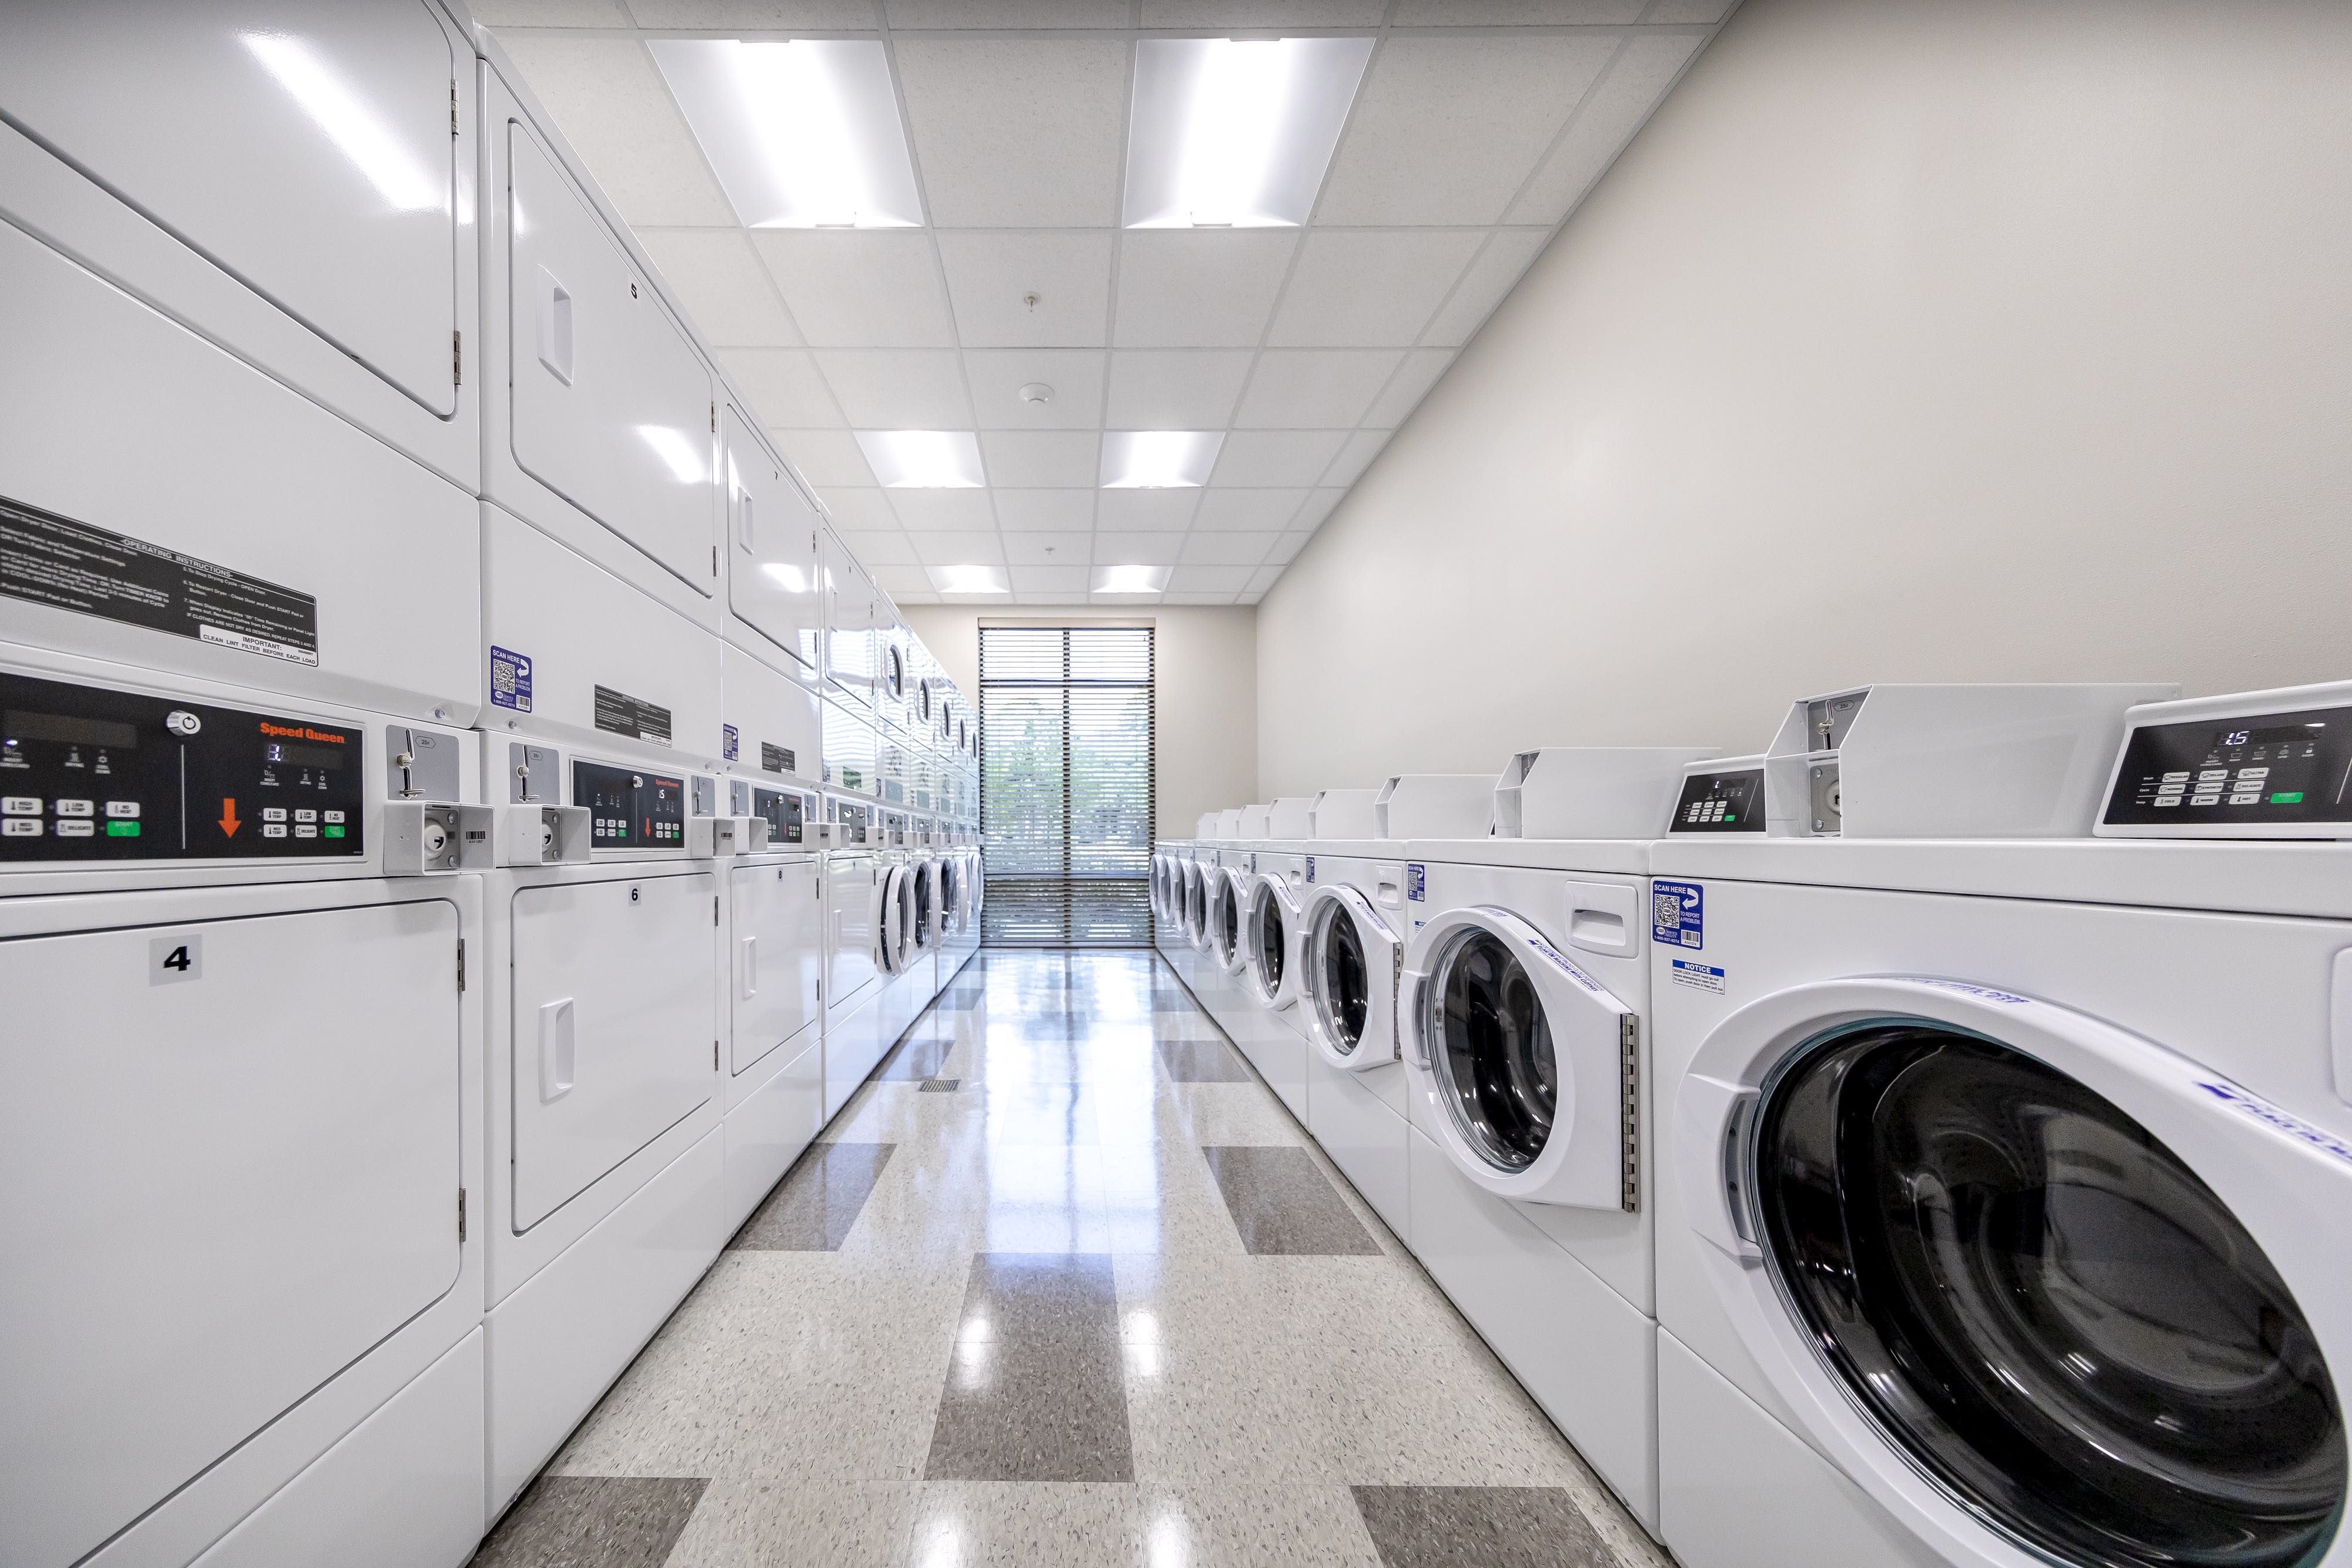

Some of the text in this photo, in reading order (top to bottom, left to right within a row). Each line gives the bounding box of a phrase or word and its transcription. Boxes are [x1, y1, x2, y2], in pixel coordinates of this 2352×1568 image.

[631, 283, 637, 299] 5
[208, 574, 223, 583] Drying
[203, 633, 223, 643] CLEAN
[226, 638, 238, 647] LINT
[242, 642, 259, 652] FILTER
[263, 647, 283, 657] BEFORE
[286, 653, 300, 661] EACH
[243, 636, 282, 651] IMPORTANT:
[493, 649, 519, 663] SCAN HERE
[260, 722, 346, 744] Speed Queen
[779, 871, 782, 880] 8
[632, 888, 639, 901] 6
[1671, 885, 1686, 894] HERE
[163, 945, 191, 971] 4
[1685, 962, 1710, 974] NOTICE
[1581, 978, 1599, 992] CLOTHES
